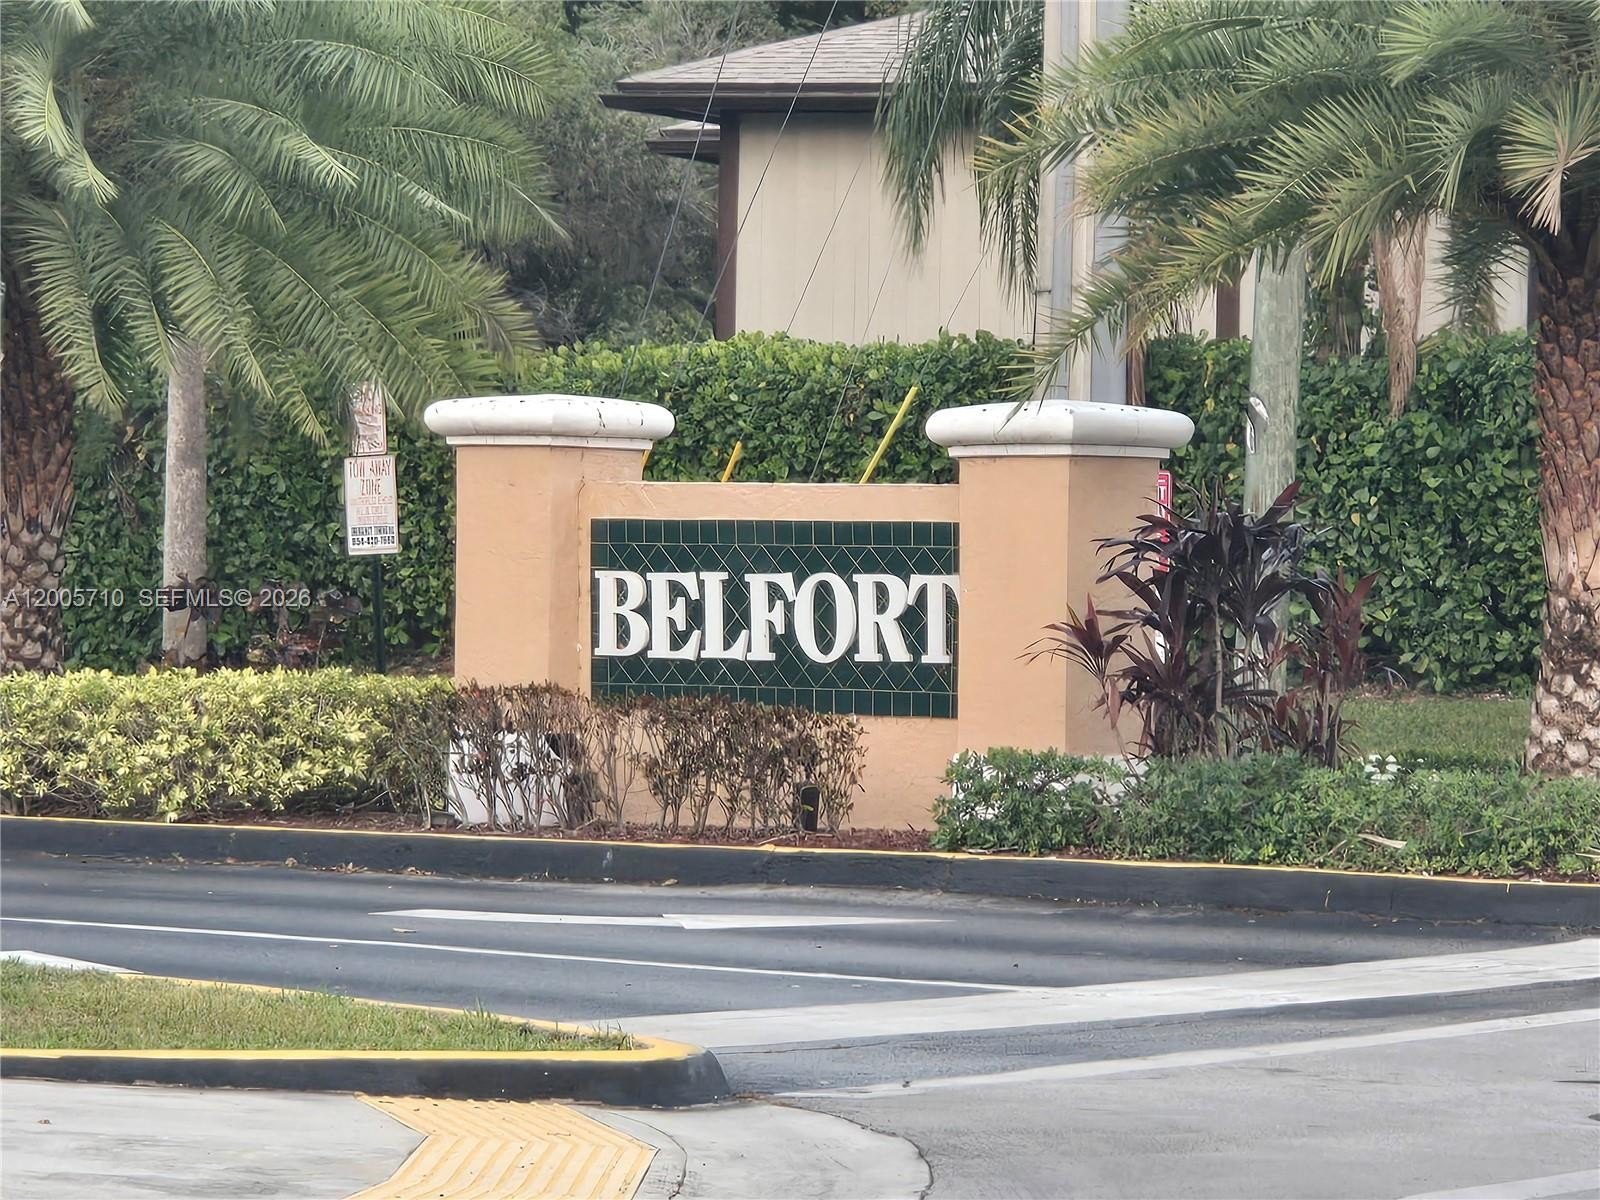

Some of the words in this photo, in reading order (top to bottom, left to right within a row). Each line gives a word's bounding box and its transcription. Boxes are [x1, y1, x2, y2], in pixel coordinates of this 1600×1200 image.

[349, 459, 365, 478] TOW
[369, 458, 392, 476] AWAY
[360, 478, 381, 496] ZONE
[594, 569, 960, 664] BELFORT
